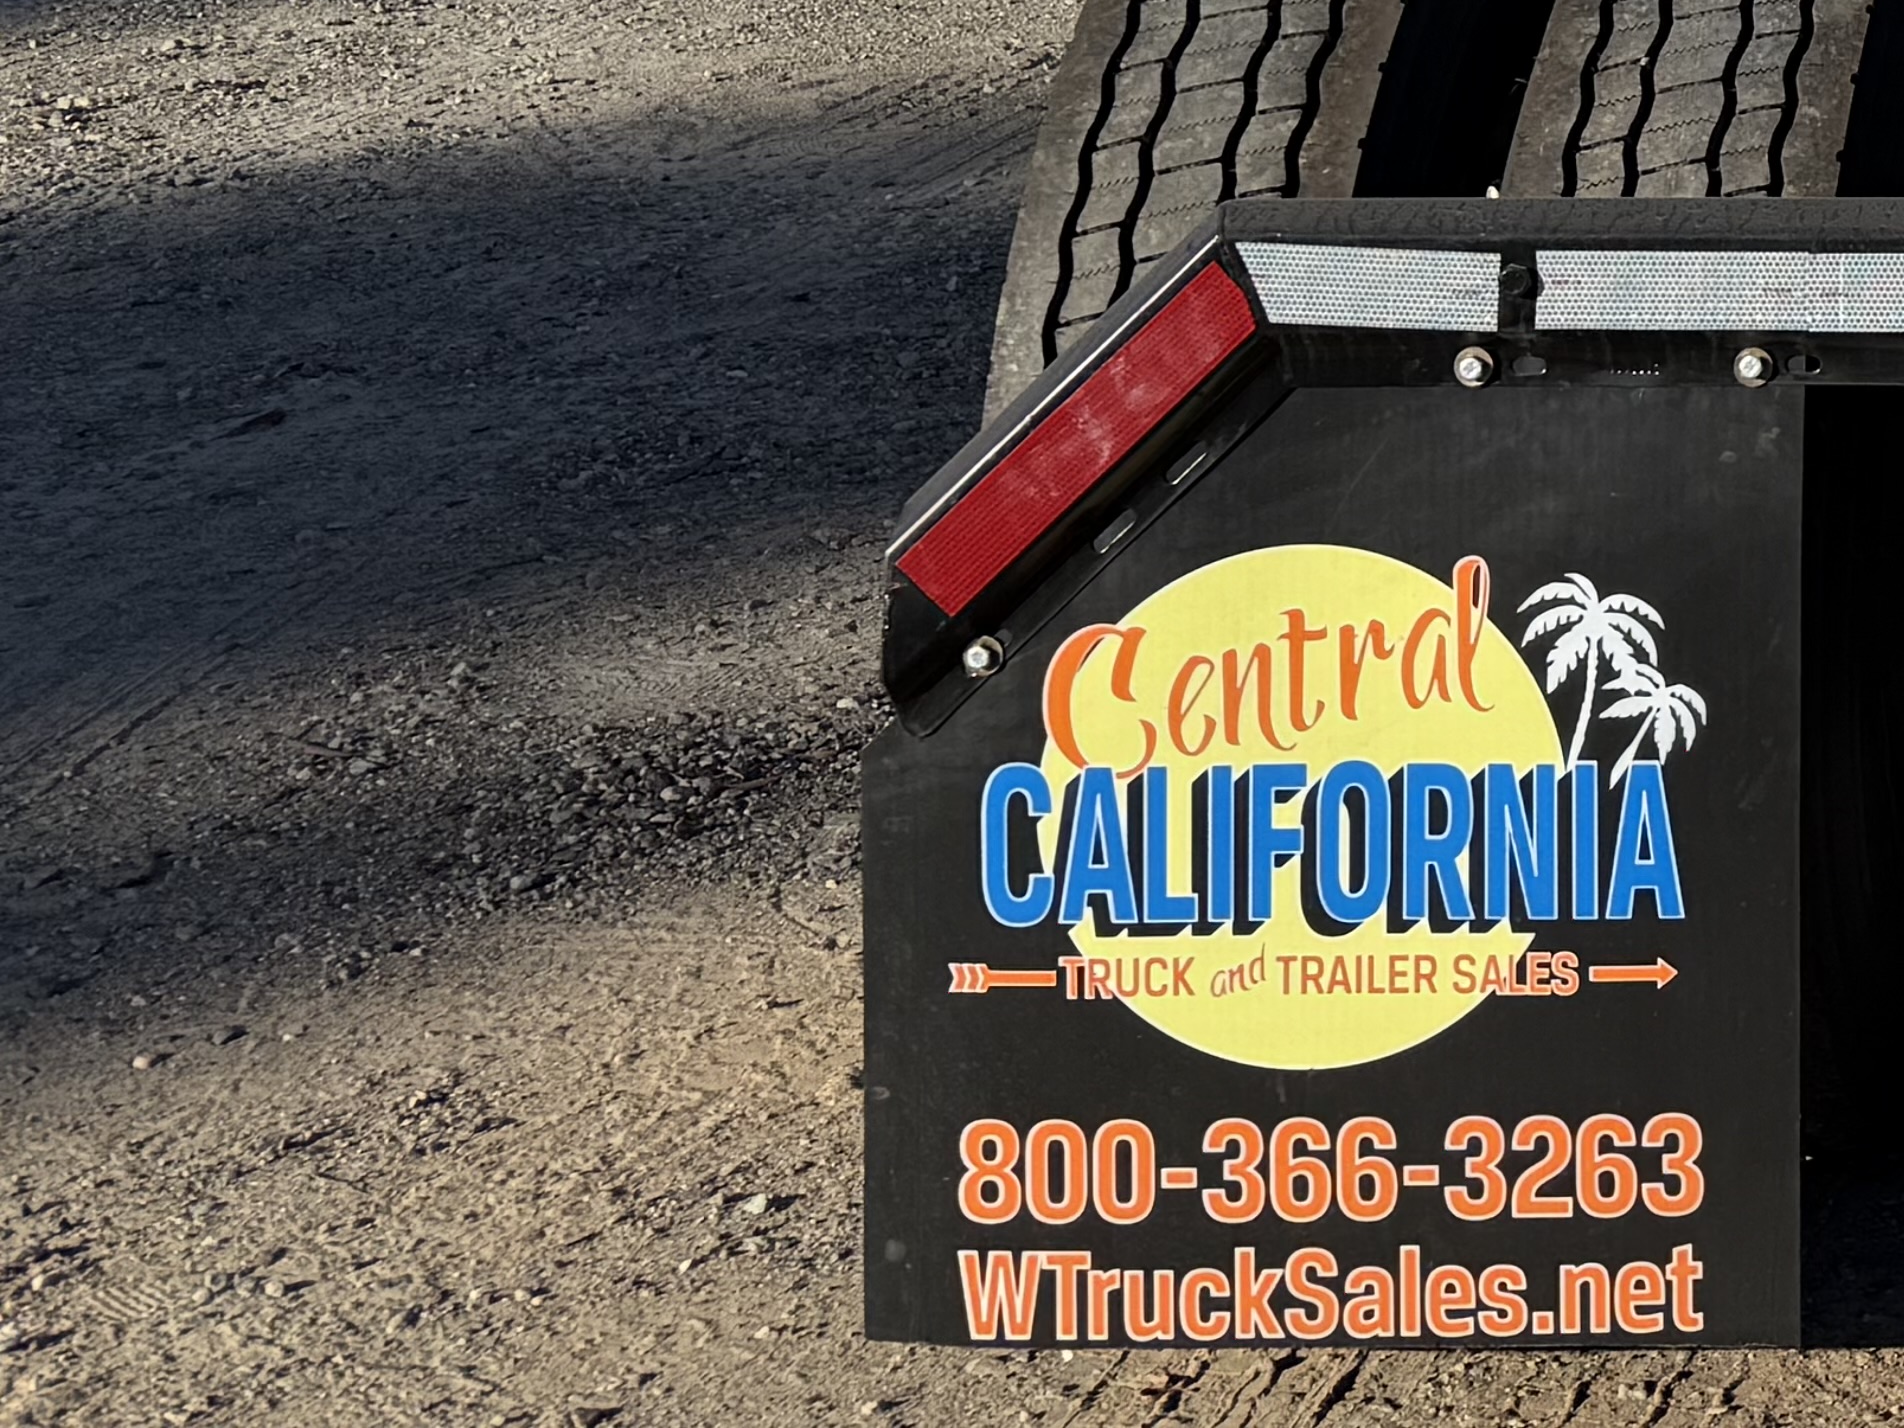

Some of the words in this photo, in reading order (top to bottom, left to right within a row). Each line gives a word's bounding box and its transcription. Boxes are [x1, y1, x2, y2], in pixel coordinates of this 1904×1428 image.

[1041, 555, 1495, 779] Central
[980, 759, 1686, 934] CALIFORNIA
[1059, 953, 1196, 1001] TRUCK
[1210, 942, 1266, 997] and
[1277, 953, 1438, 996] TRAILER
[1451, 950, 1580, 997] SALES
[957, 1111, 1705, 1226] 800-366-3263
[957, 1242, 1705, 1341] WTruckSales.net
